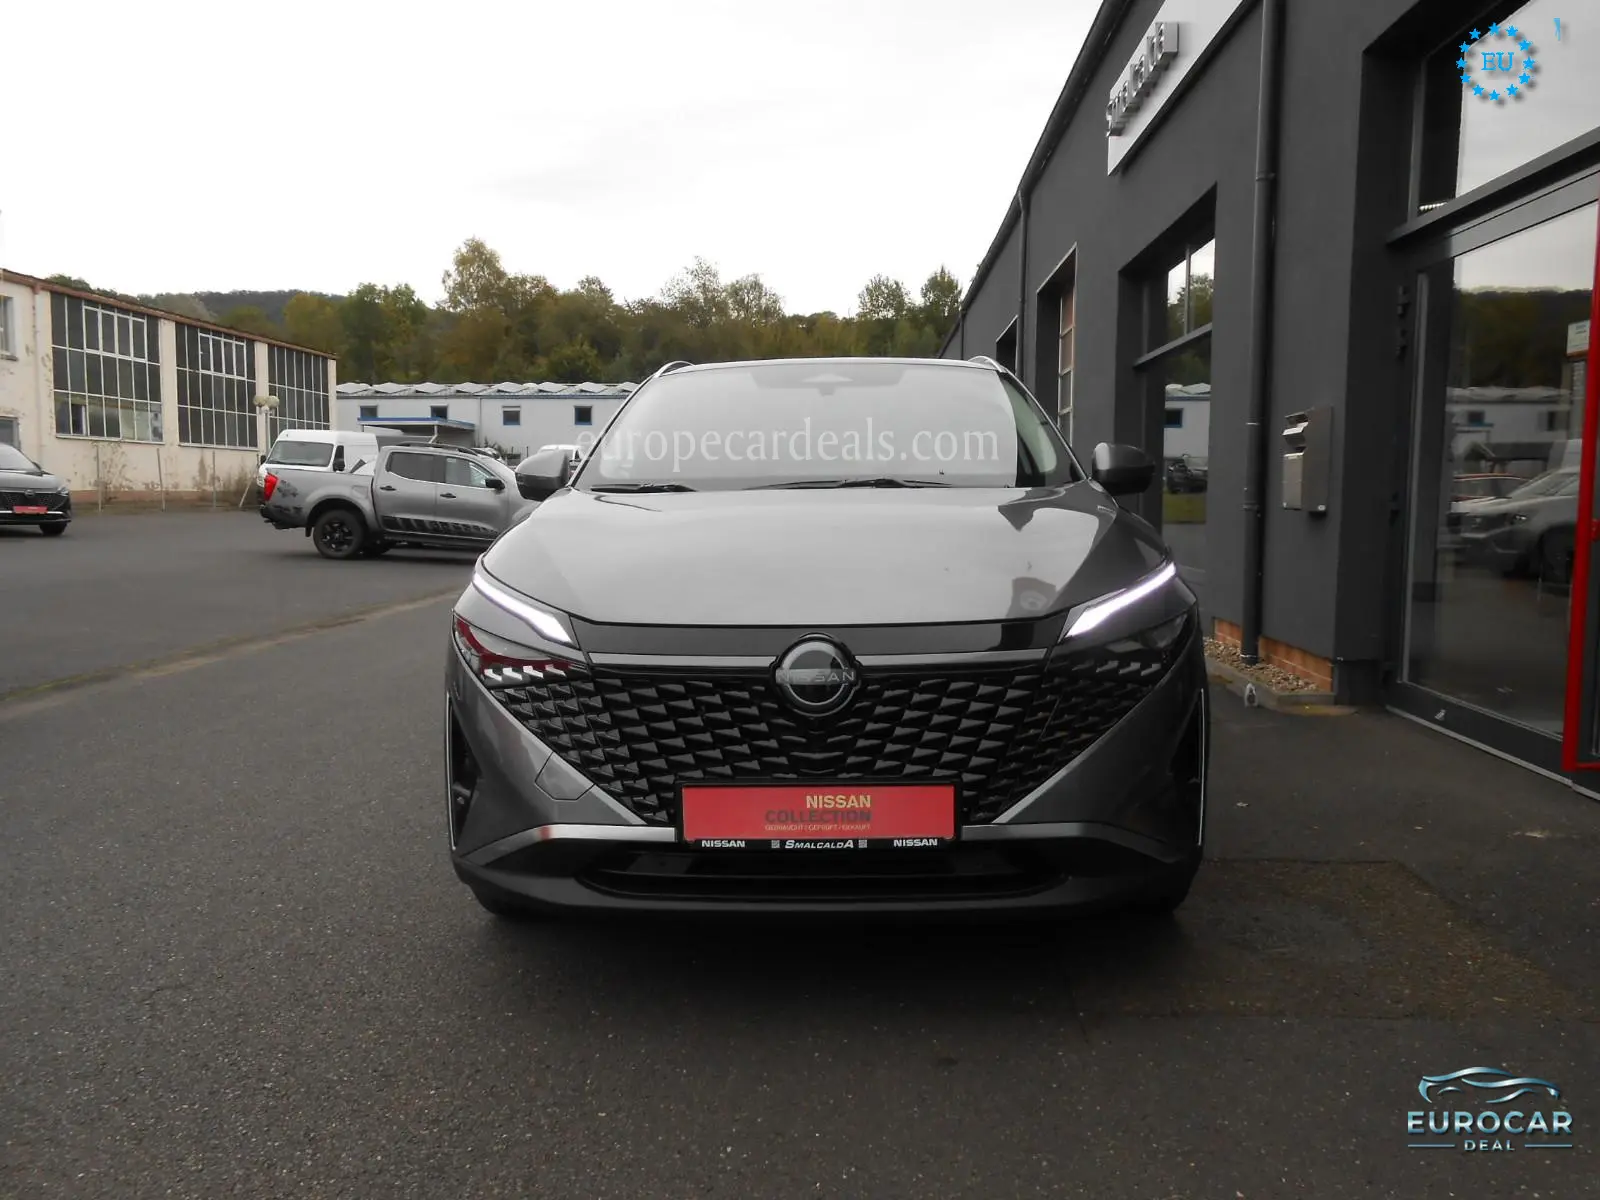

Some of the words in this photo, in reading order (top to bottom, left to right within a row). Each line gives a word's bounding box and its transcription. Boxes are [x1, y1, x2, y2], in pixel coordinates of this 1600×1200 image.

[776, 670, 855, 683] NISSAN
[805, 794, 871, 809] NISSAN
[765, 809, 872, 823] COLLECTION
[701, 839, 746, 849] NISSAN
[893, 838, 938, 848] NISSAN
